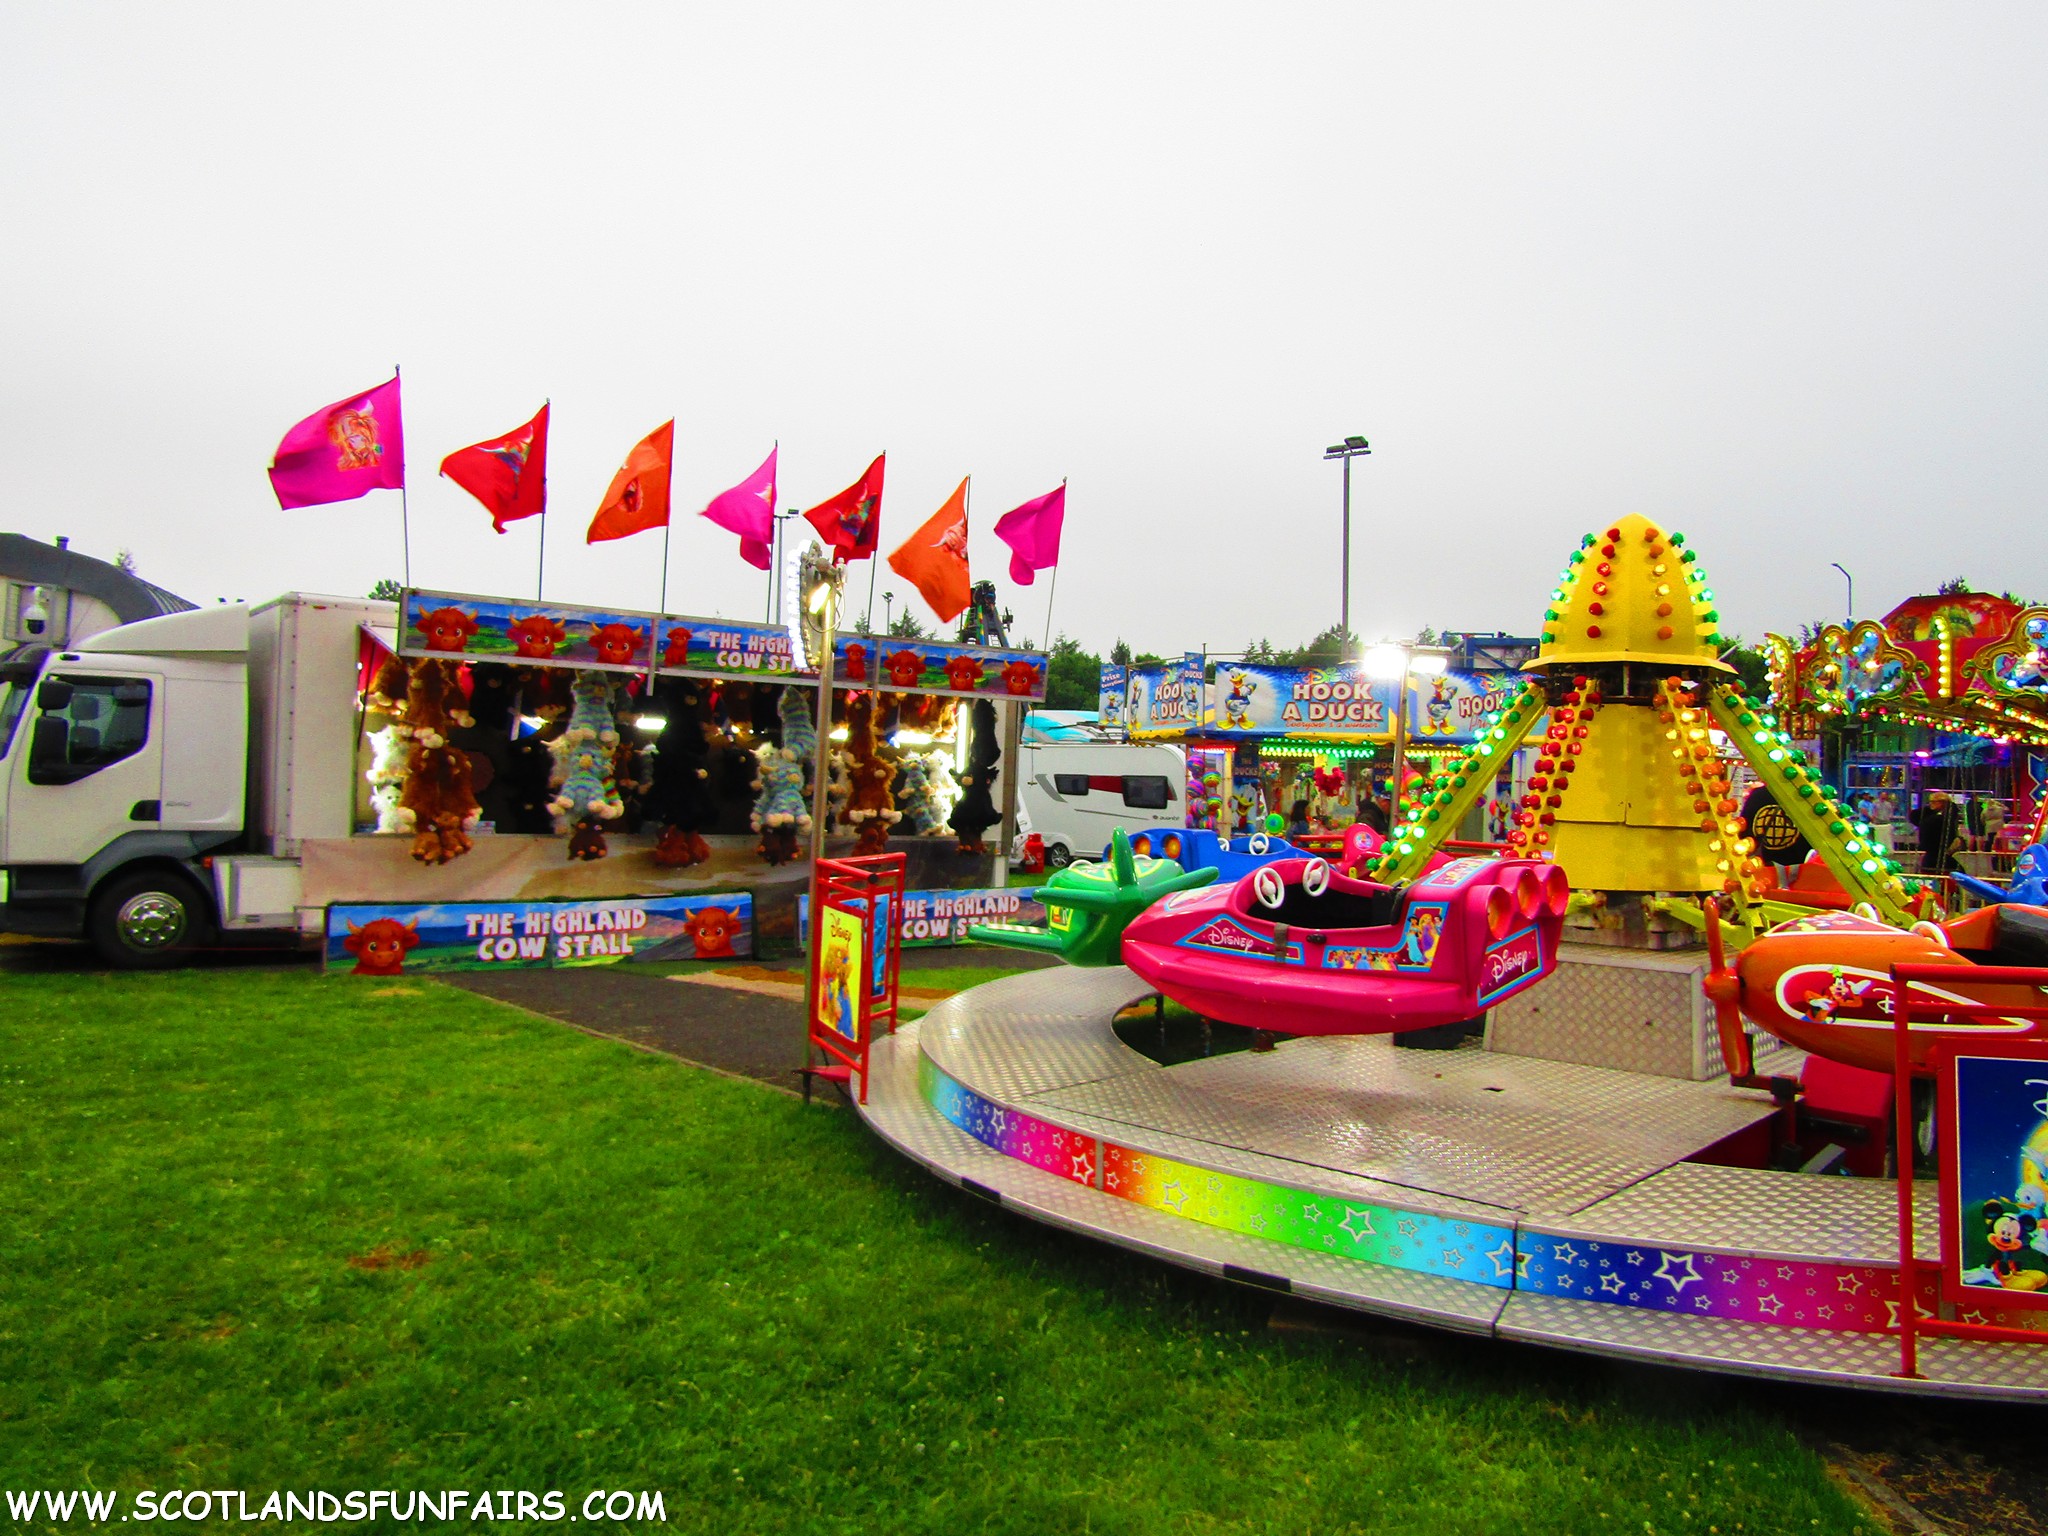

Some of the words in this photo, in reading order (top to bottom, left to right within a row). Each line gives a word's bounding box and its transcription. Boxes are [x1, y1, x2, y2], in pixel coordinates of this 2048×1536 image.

[708, 630, 741, 649] THE
[716, 650, 761, 669] COW
[1184, 670, 1203, 679] DUCKS
[1155, 682, 1184, 701] HOO
[1293, 682, 1374, 701] HOOK
[1150, 703, 1158, 720] A
[1161, 700, 1184, 718] DUC
[1281, 702, 1302, 721] A
[1309, 702, 1384, 721] DUCK
[465, 912, 515, 936] THE
[902, 918, 950, 939] COW
[477, 936, 547, 961] COW
[556, 932, 634, 958] STALL
